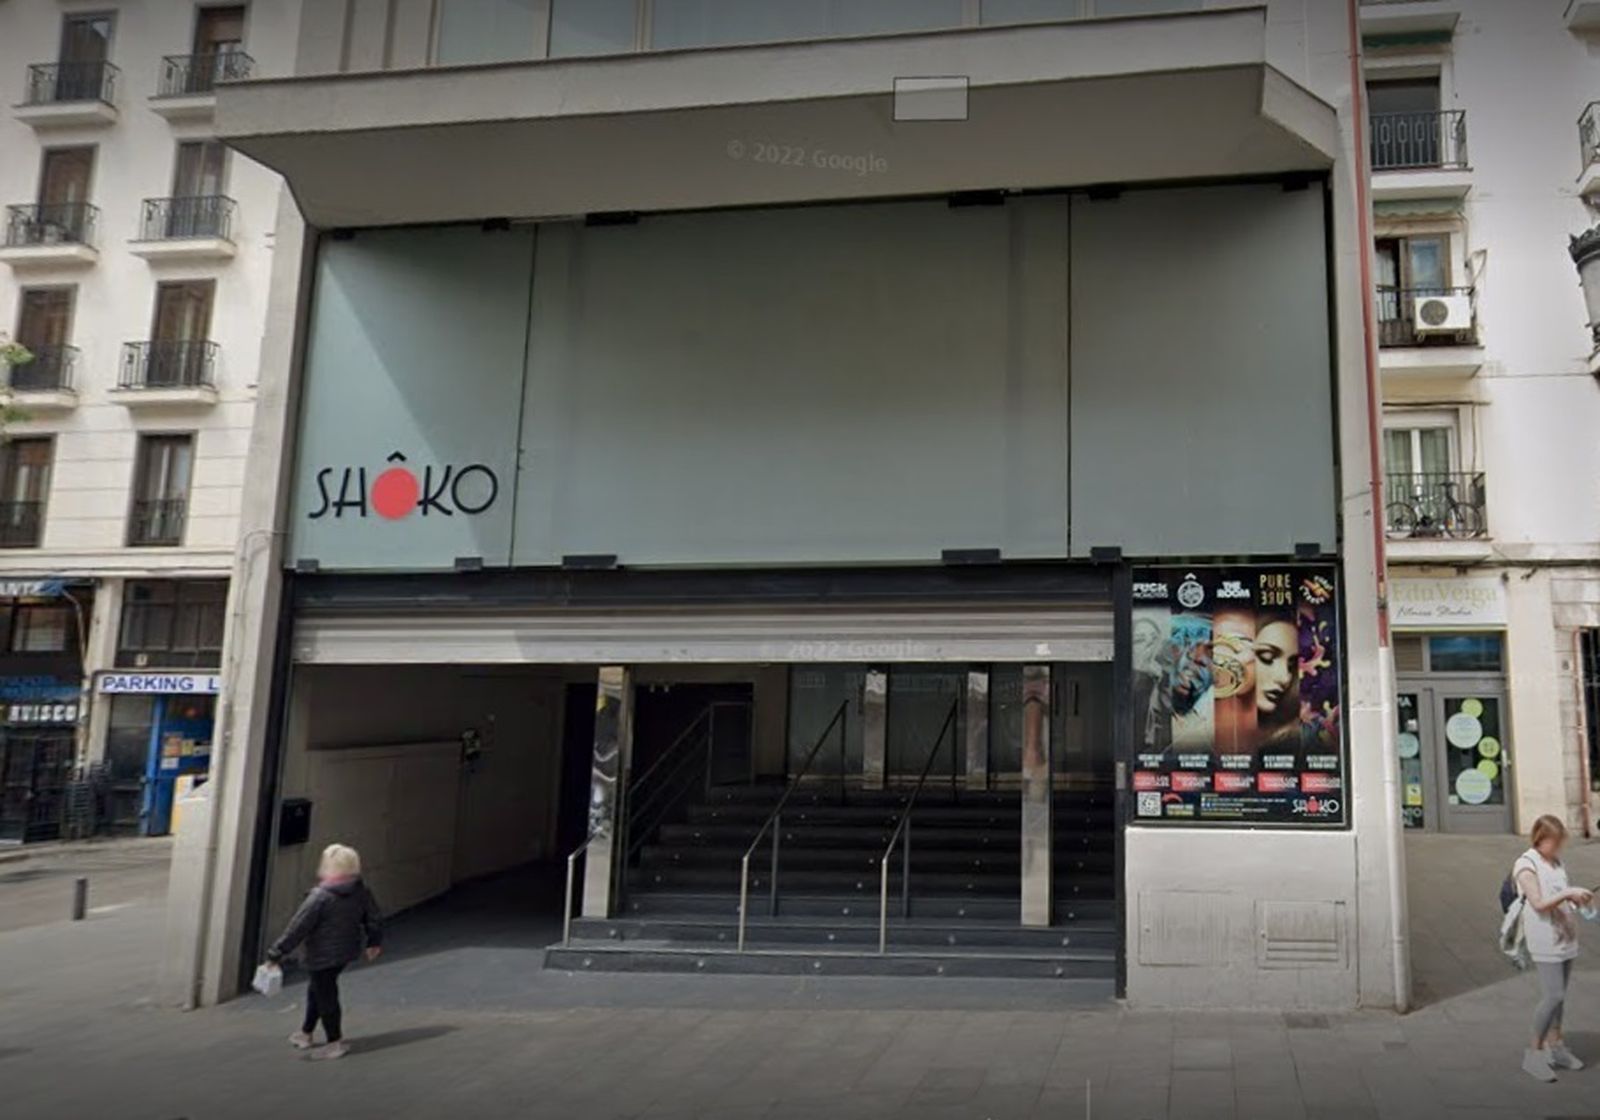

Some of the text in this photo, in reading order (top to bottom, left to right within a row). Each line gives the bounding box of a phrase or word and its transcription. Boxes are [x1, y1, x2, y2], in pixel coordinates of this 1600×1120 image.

[1260, 574, 1291, 588] PURE
[1216, 589, 1251, 598] ROOM
[102, 676, 194, 690] PARKING
